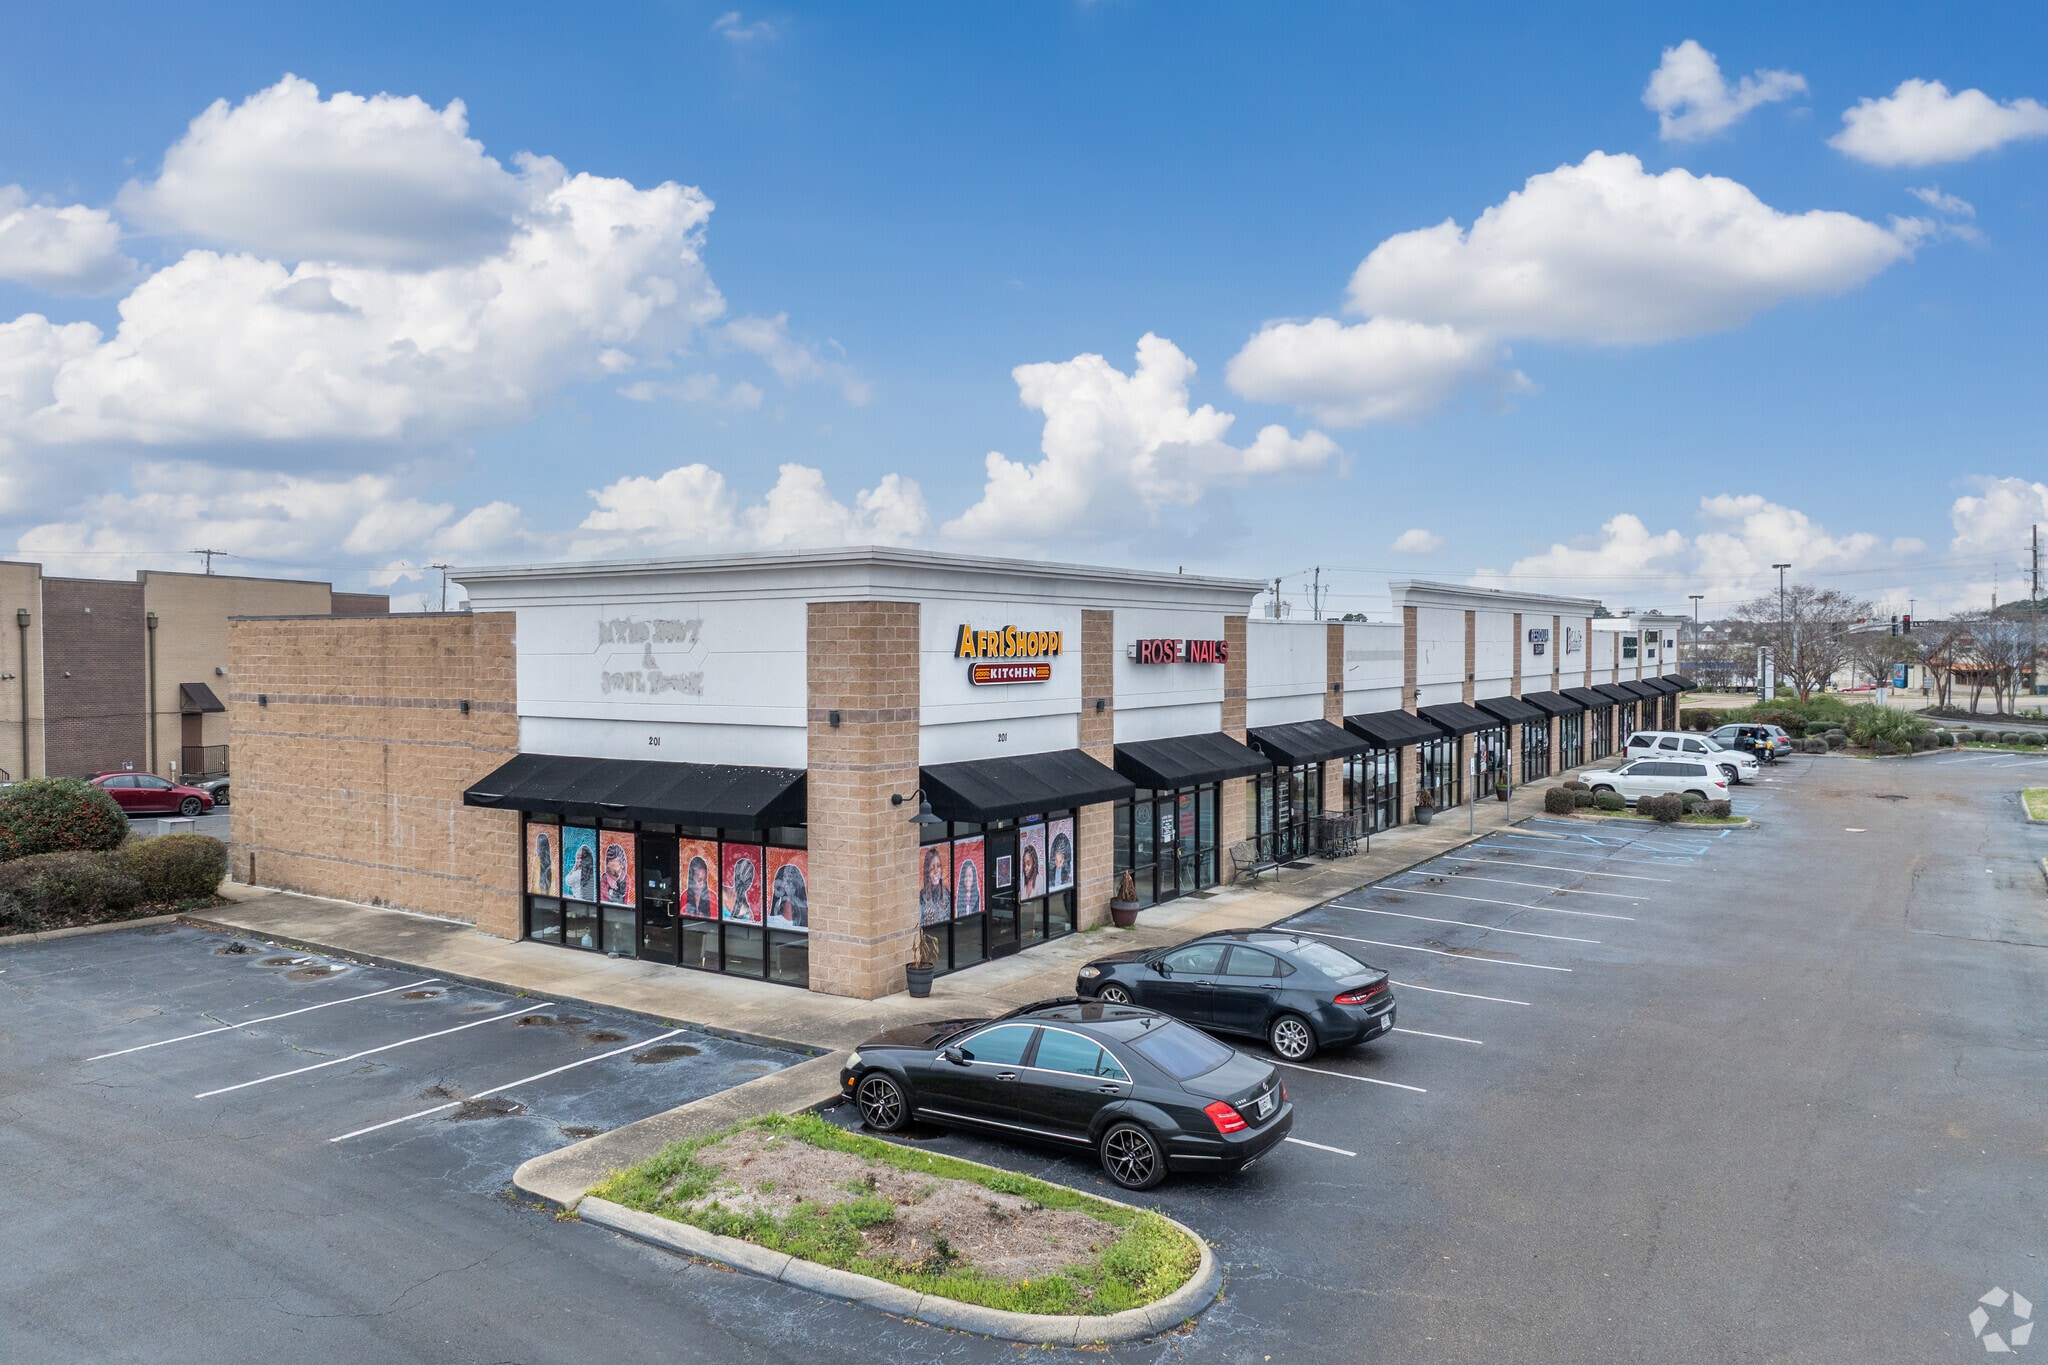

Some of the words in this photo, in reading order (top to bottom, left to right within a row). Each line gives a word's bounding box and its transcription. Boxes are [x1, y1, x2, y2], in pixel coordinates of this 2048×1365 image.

[1140, 639, 1183, 664] ROSE
[1190, 639, 1229, 664] NAILS
[990, 667, 1037, 679] KITCHEN
[648, 736, 661, 746] 201
